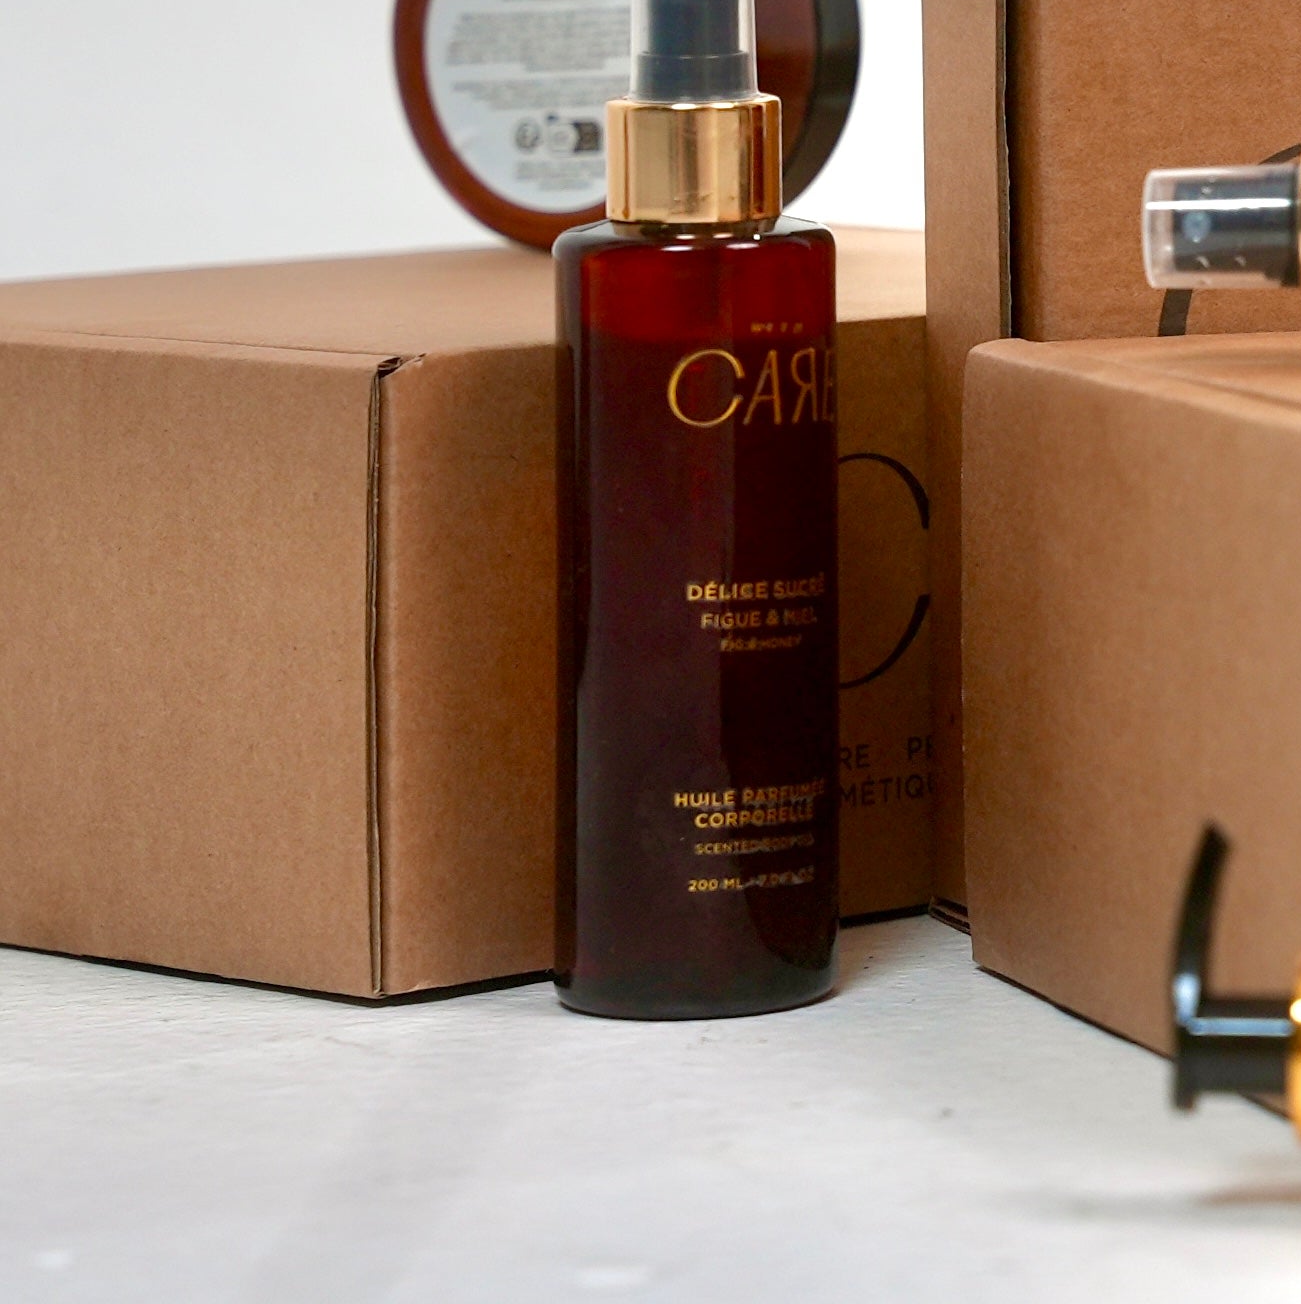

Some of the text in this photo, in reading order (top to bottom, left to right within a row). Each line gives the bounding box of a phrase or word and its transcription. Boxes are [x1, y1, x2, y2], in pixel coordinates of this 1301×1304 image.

[686, 580, 769, 602] DÉLICE
[700, 610, 762, 630] FIGUE
[765, 608, 780, 627] &
[673, 788, 737, 809] HUILE
[694, 799, 815, 830] CORPORELLE
[687, 877, 720, 893] 200
